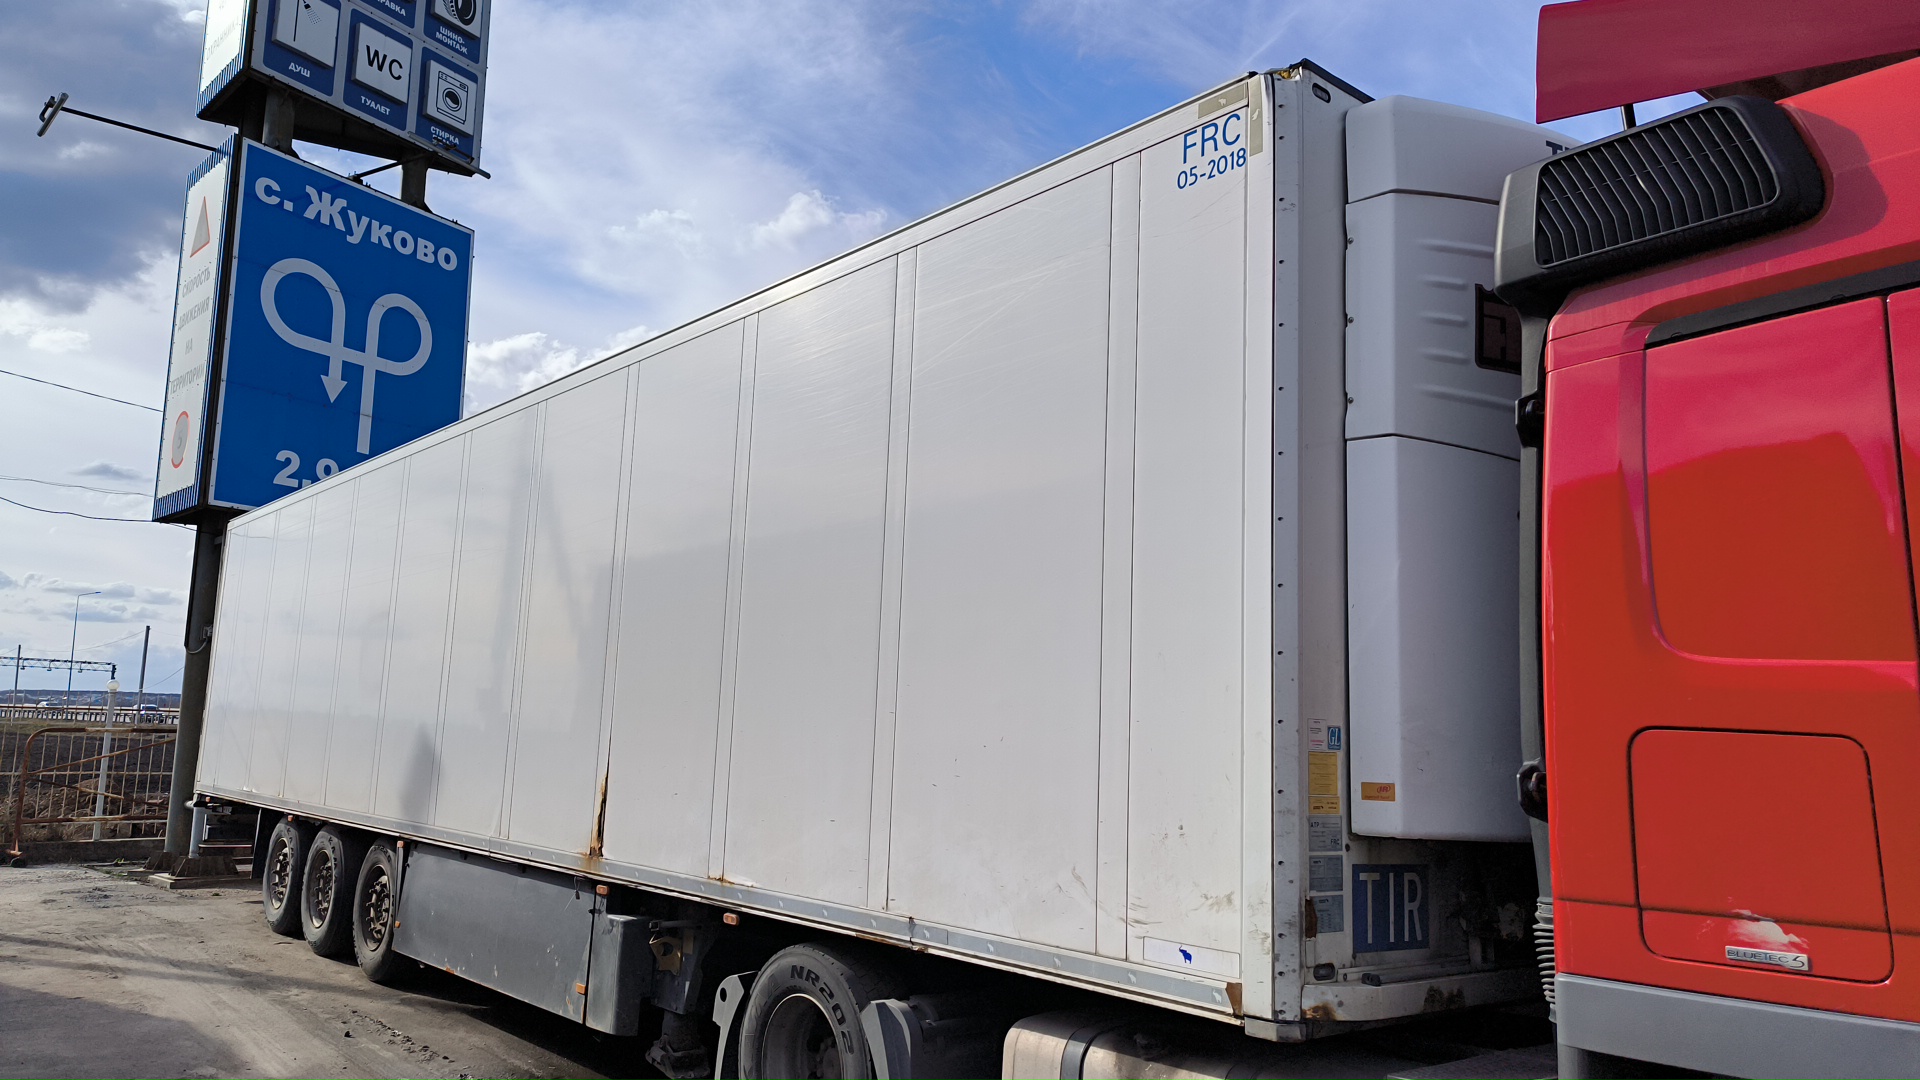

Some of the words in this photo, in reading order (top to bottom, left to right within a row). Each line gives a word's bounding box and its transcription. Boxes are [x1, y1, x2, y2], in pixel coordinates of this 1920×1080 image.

[377, 0, 407, 16] РАВКА
[436, 32, 468, 55] МОНТАЖ
[440, 26, 465, 43] ШИНО-
[288, 62, 310, 78] ДУШ
[366, 44, 403, 80] WC
[361, 95, 391, 115] ТУАЛЕТ
[430, 126, 460, 145] СТИРКА
[1183, 113, 1241, 164] FRC
[1177, 147, 1247, 189] 05-2018
[254, 177, 293, 211] с.
[303, 185, 458, 271] Жуково
[182, 267, 211, 298] СКОРОСТЬ
[178, 297, 210, 332] ДВИЖЕНИЯ
[185, 338, 193, 355] НА
[170, 362, 205, 395] ТЕРРИТОРИИ
[1359, 872, 1423, 944] TIR
[790, 965, 855, 1055] NR202
